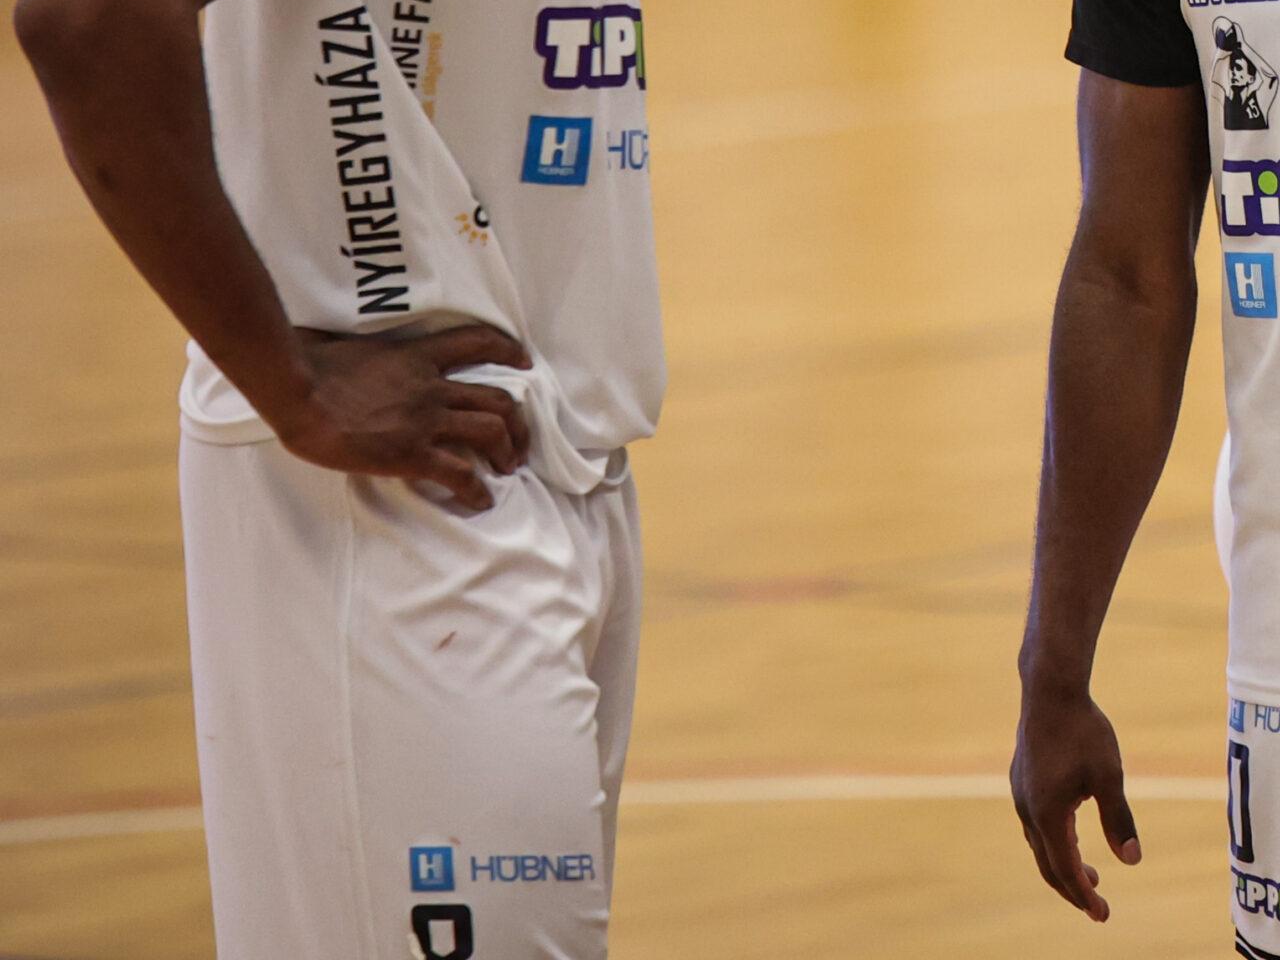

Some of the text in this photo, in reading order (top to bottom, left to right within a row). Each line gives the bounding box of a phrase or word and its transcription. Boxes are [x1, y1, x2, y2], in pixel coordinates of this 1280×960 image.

[1246, 98, 1260, 119] 15
[314, 5, 411, 315] NYÍREGYHÁZA
[470, 854, 597, 883] HÜBNER
